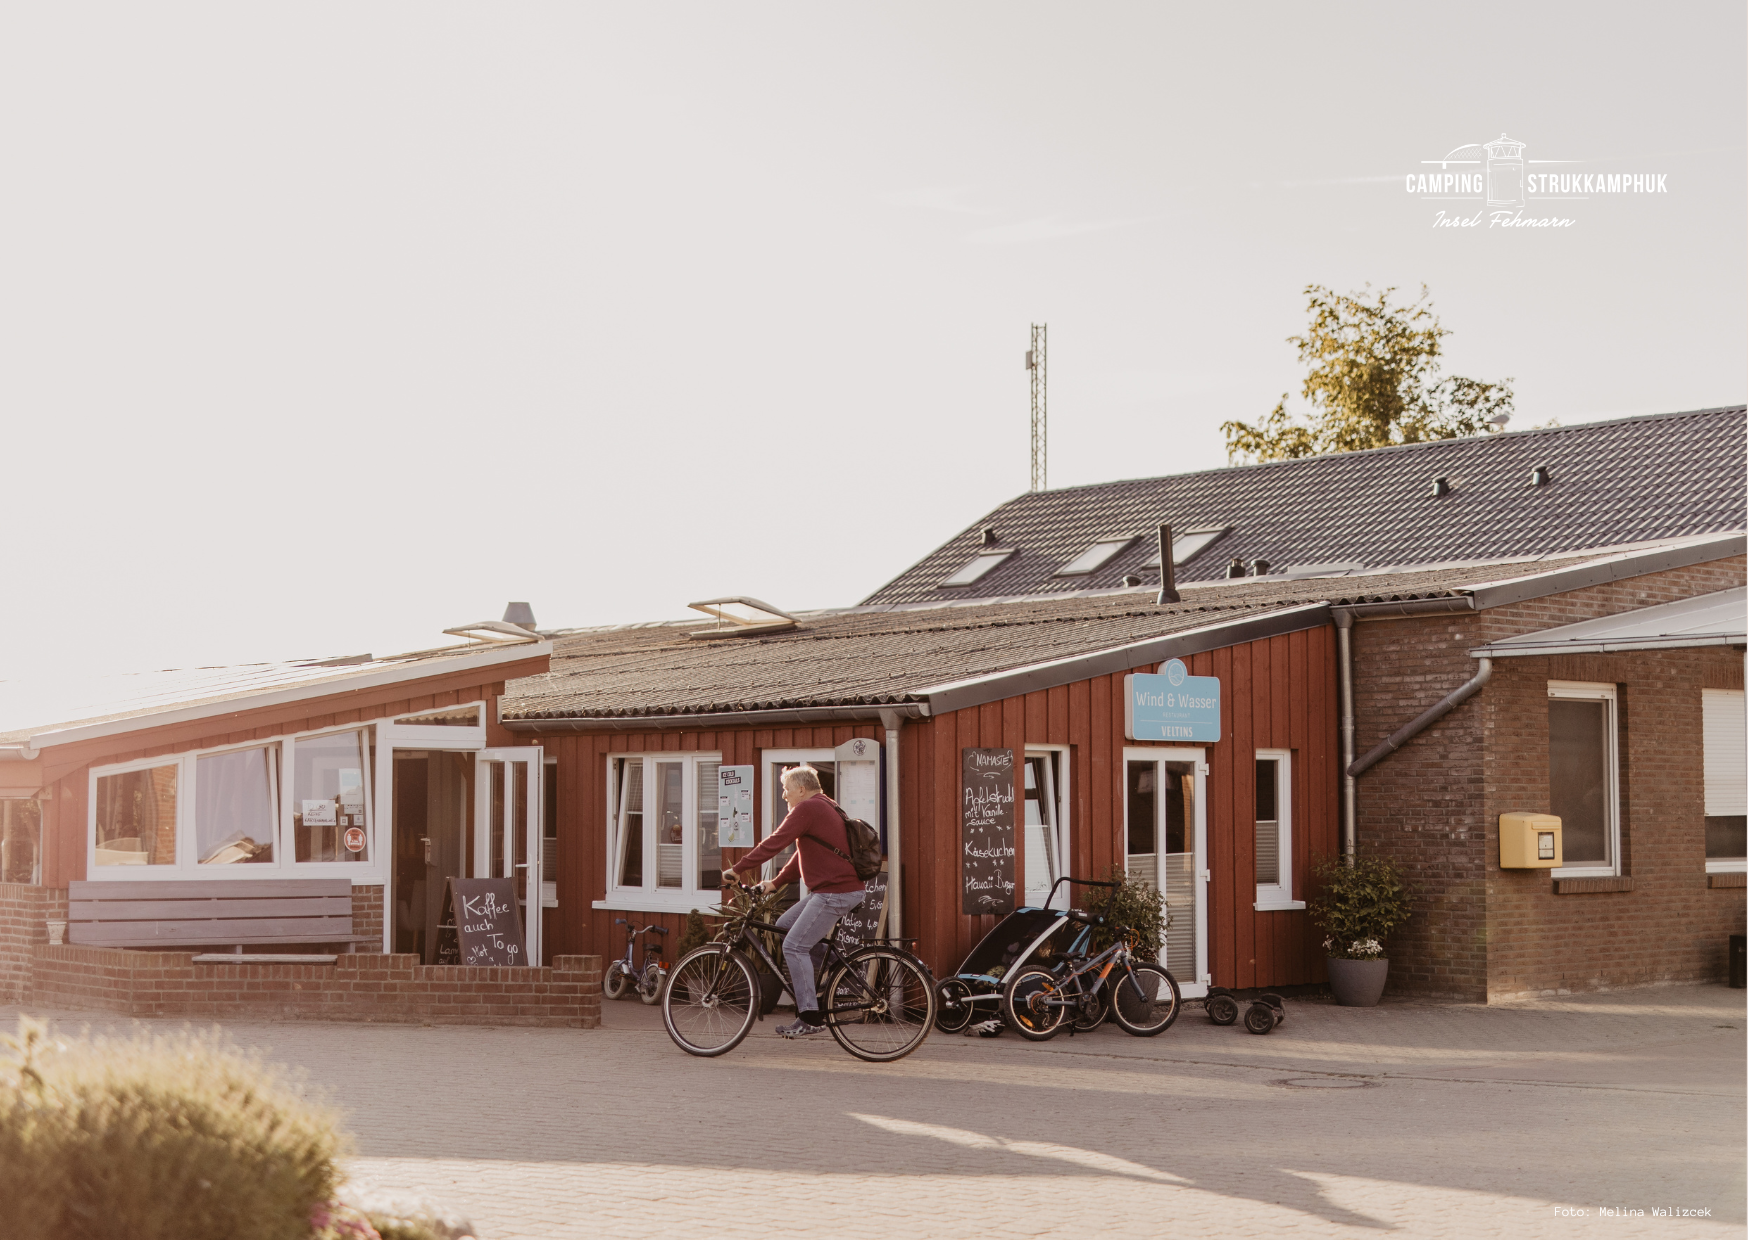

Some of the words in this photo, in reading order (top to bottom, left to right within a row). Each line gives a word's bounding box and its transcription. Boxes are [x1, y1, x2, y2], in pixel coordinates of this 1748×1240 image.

[1136, 691, 1164, 707] Wind
[1167, 692, 1175, 708] &
[1178, 693, 1217, 709] Wasser
[1161, 725, 1193, 738] VELTINS
[965, 807, 980, 819] mit
[462, 892, 510, 920] Kaffee
[464, 919, 494, 933] auch
[486, 933, 504, 949] To
[507, 944, 518, 965] go
